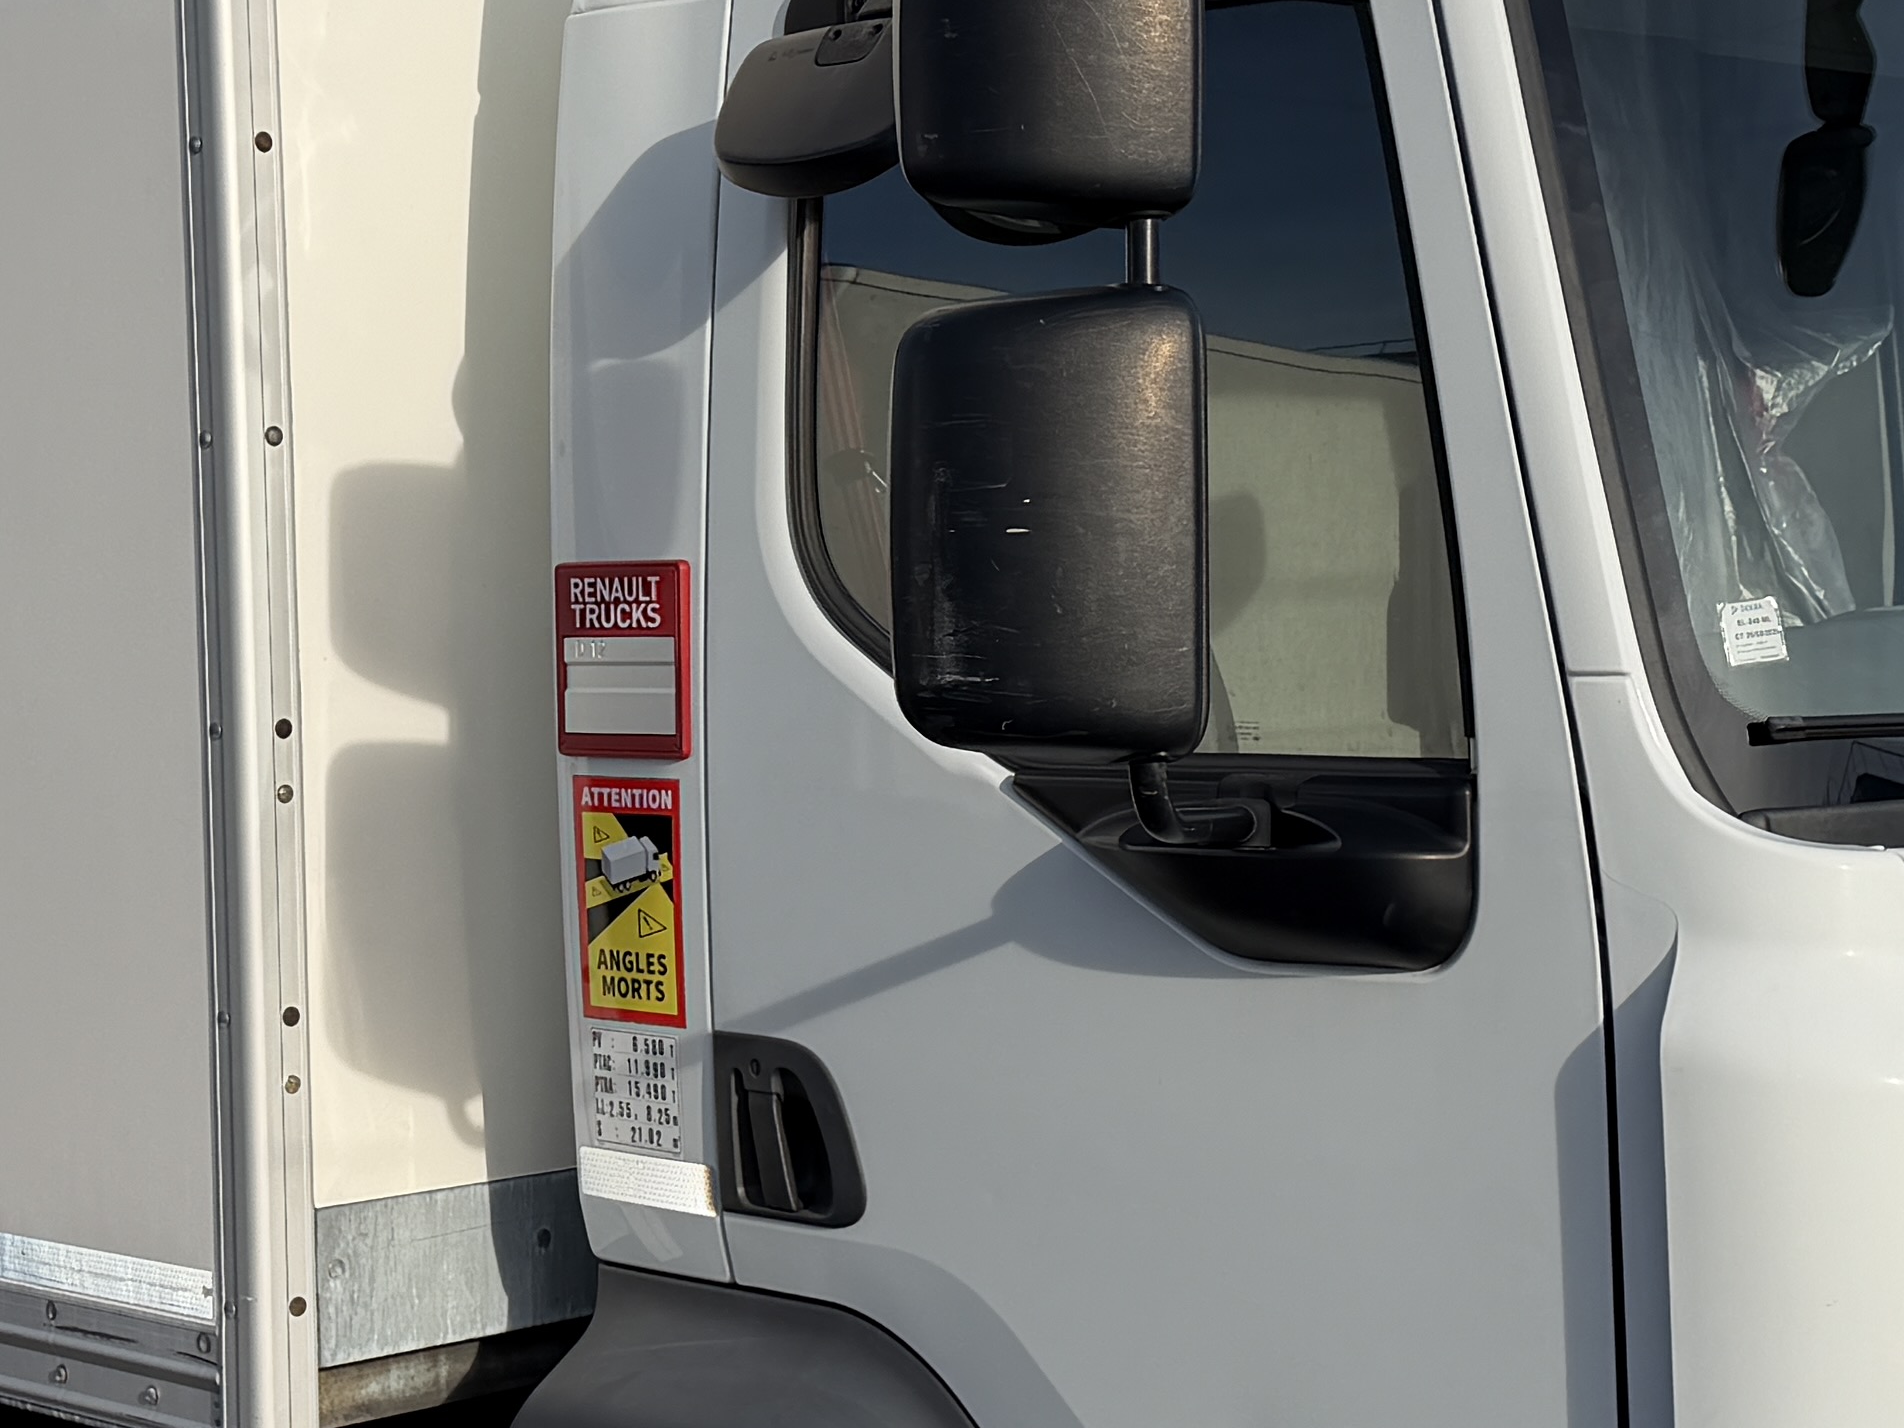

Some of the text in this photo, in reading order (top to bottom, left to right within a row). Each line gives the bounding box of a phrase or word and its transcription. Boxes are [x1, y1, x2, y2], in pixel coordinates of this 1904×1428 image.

[570, 576, 660, 603] RENAULT
[571, 603, 662, 628] TRUCKS
[581, 786, 673, 810] ATTENTION
[597, 948, 668, 976] ANGLES
[602, 974, 666, 1002] MORTS
[631, 1125, 662, 1147] 21.02
